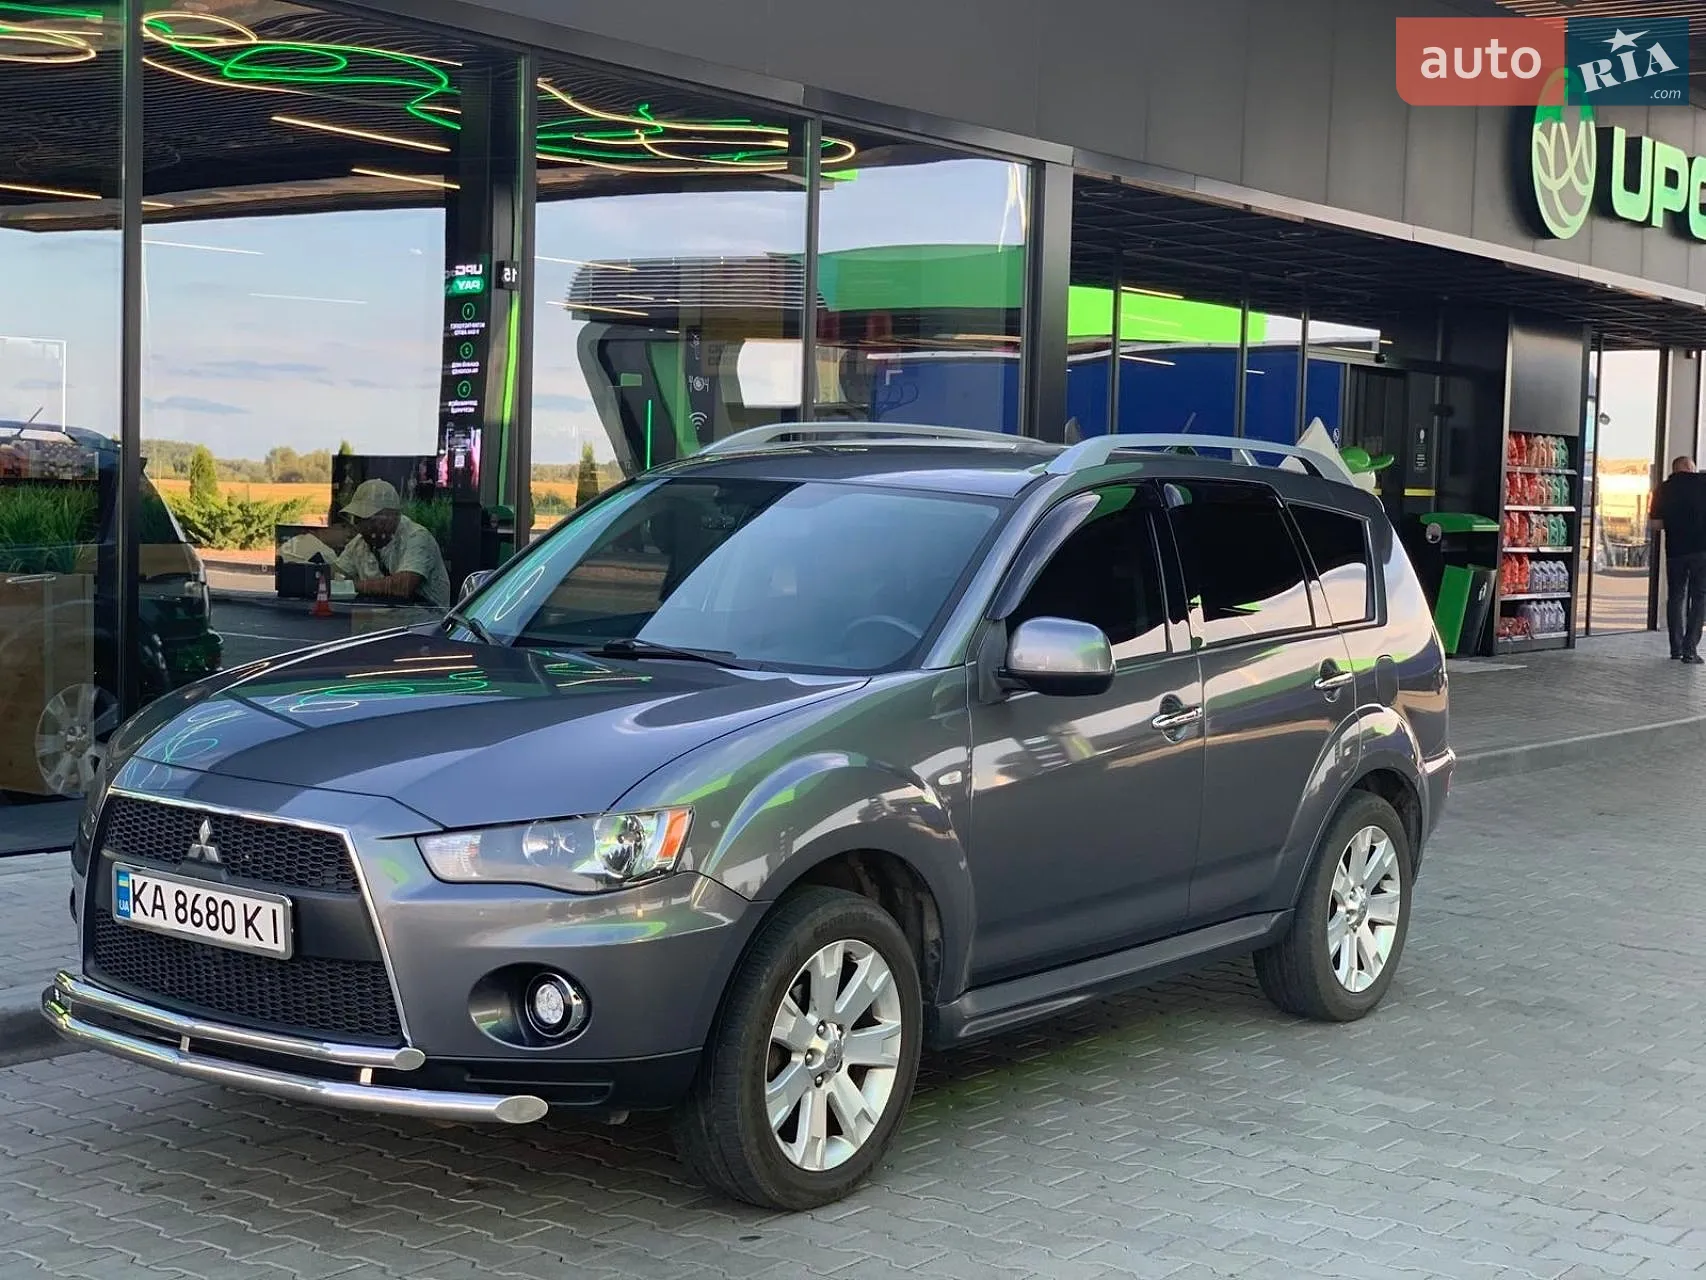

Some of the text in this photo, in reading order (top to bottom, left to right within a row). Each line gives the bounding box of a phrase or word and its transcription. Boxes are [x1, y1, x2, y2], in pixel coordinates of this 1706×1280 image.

[118, 898, 130, 912] UA
[131, 879, 279, 944] KA 8680 KI
